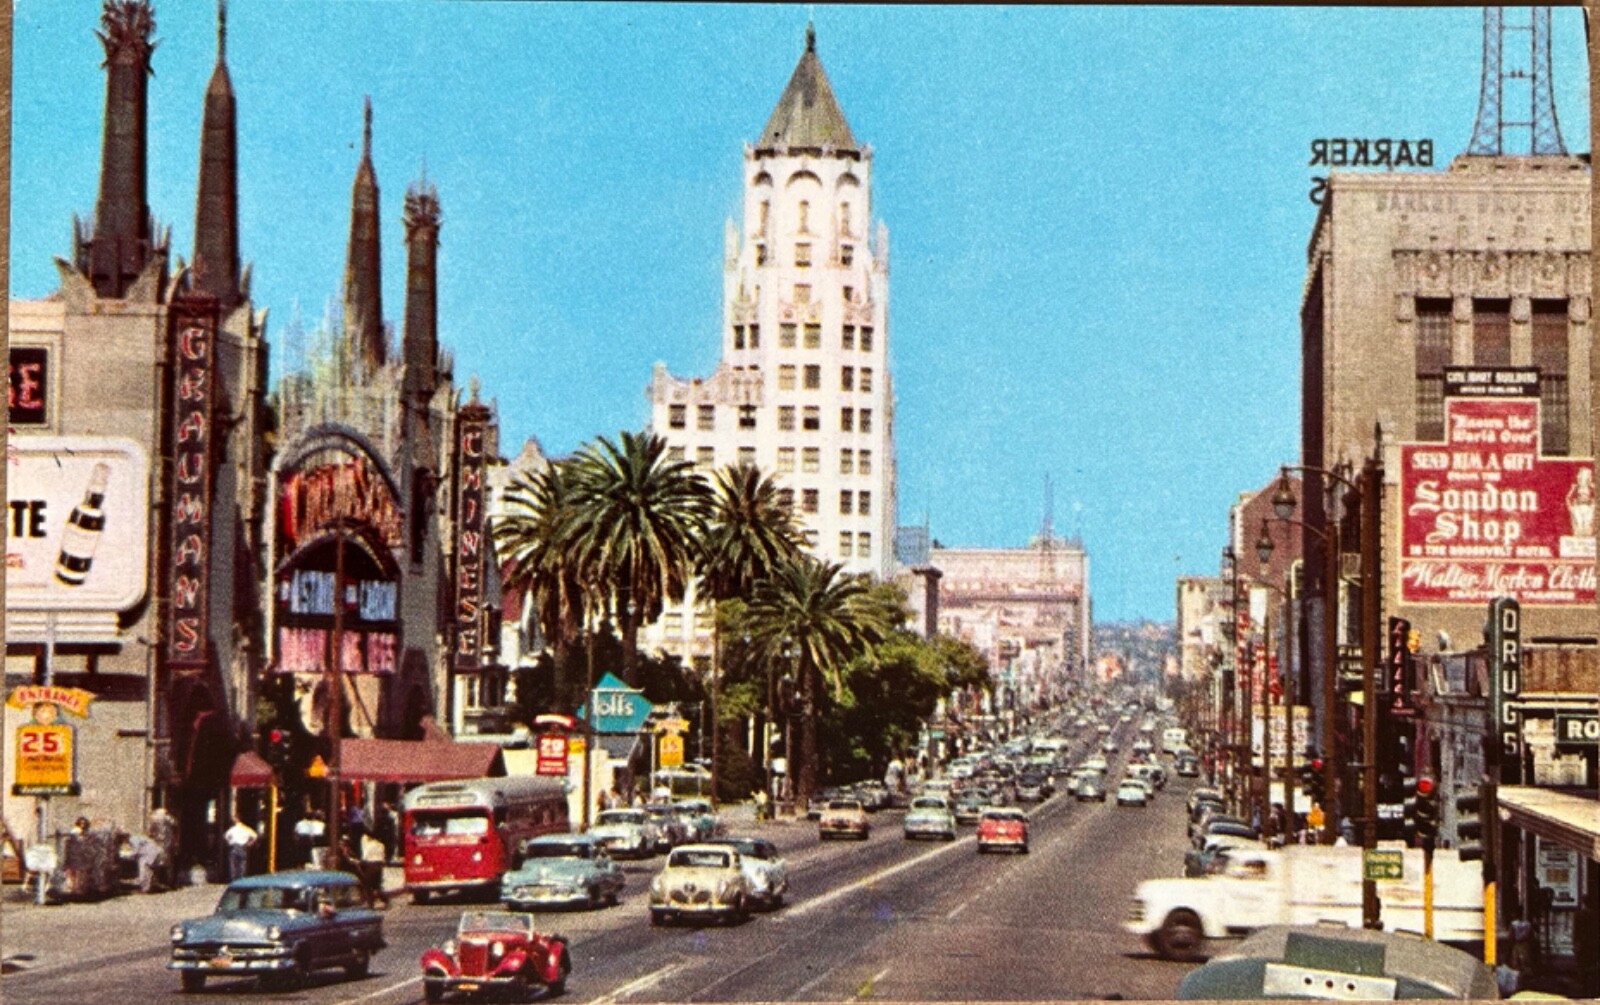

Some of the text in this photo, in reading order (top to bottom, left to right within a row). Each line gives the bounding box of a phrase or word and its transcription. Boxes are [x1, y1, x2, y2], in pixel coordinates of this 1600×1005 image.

[1411, 452, 1449, 469] SEND
[1485, 452, 1500, 469] A
[1502, 453, 1534, 470] GIFT
[1425, 511, 1520, 545] Shop
[461, 431, 481, 655] CHINESE
[1502, 608, 1517, 756] DRUGS
[19, 687, 79, 708] ENTRANCE
[22, 732, 58, 753] 25
